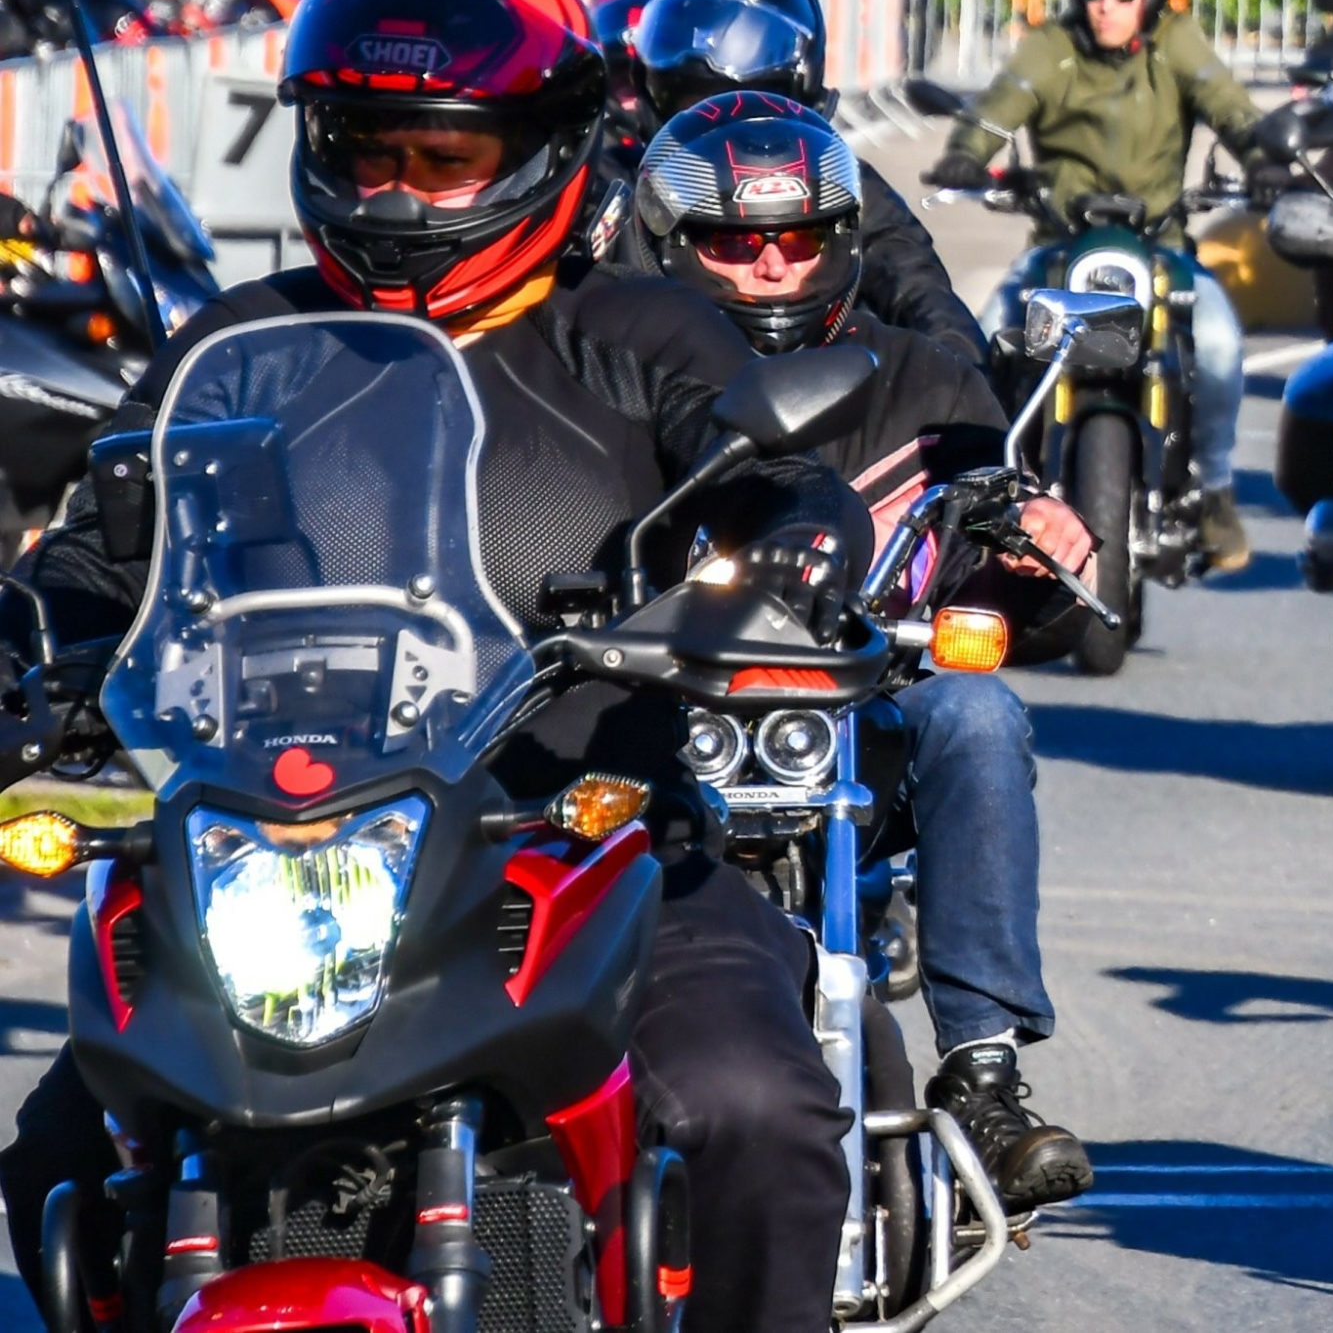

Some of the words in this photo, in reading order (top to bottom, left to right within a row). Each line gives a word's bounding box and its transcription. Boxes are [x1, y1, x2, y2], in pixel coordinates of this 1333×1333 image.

[359, 39, 438, 71] SHOEI
[263, 733, 338, 749] HONDA
[723, 791, 780, 800] HONDA
